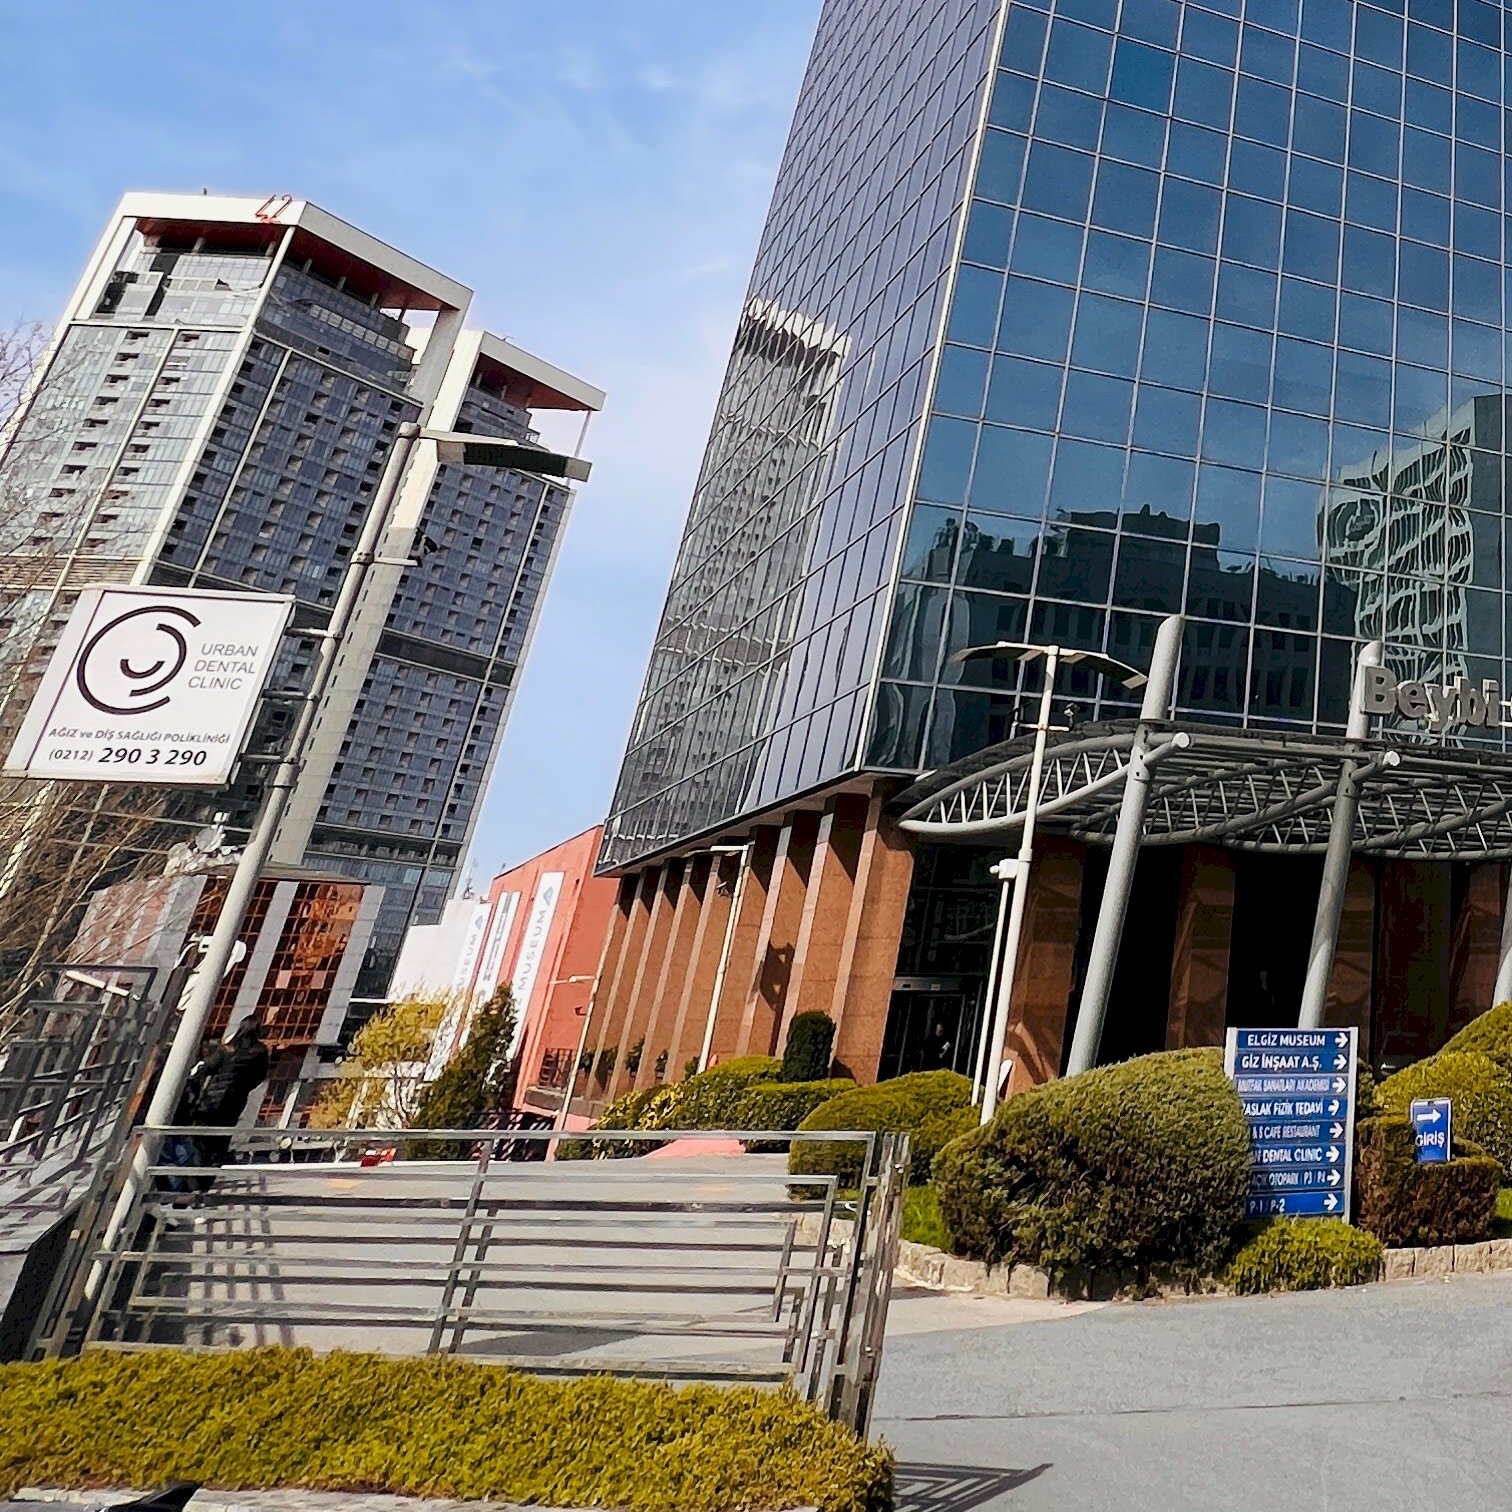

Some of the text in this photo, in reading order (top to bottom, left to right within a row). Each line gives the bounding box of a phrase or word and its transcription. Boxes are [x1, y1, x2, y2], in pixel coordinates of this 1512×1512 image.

[201, 643, 259, 657] URBAN
[194, 659, 256, 674] DENTAL
[188, 676, 243, 690] CLINIC
[1360, 664, 1500, 734] Beybi
[49, 727, 79, 739] AĞIZ
[80, 731, 93, 739] ve
[94, 728, 115, 742] DİŞ
[49, 747, 208, 766] (0212) 290 3 290
[1247, 1031, 1326, 1047] ELGİZ MUSEUM
[1241, 1053, 1260, 1068] GİZ
[1261, 1052, 1301, 1072] İNŞAAT
[1273, 1098, 1294, 1116] FİZİK
[1295, 1097, 1324, 1116] TEDAVİ
[1414, 1130, 1445, 1149] GİRİŞ
[1262, 1148, 1293, 1164] DENTAL
[1293, 1147, 1323, 1162] CLINIC
